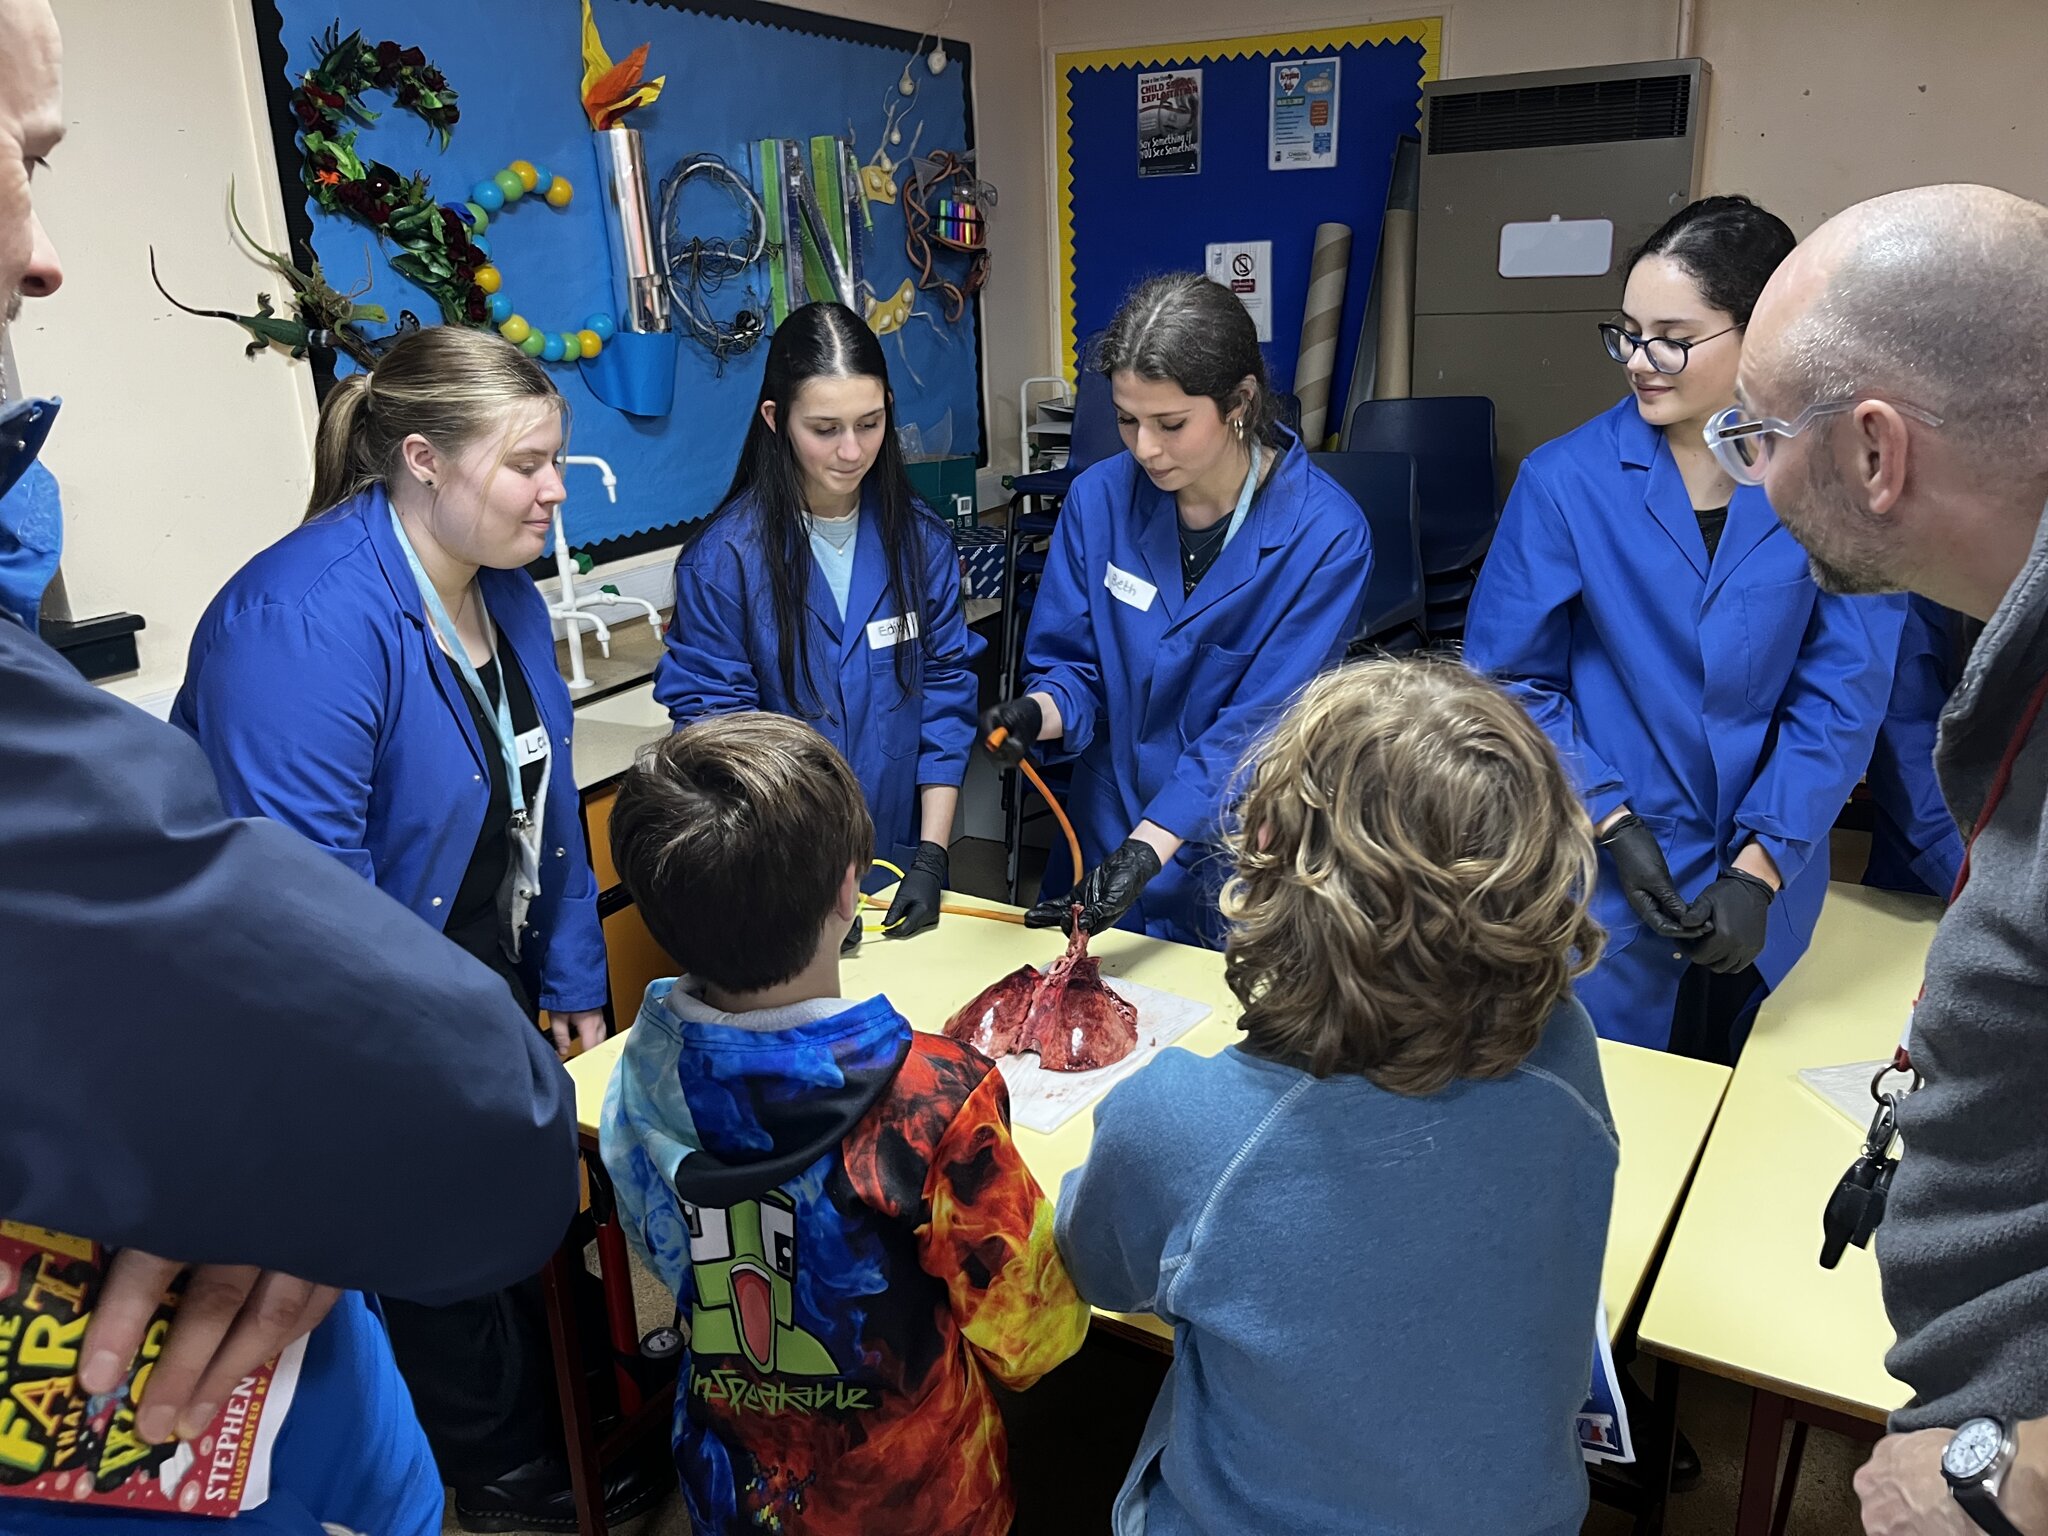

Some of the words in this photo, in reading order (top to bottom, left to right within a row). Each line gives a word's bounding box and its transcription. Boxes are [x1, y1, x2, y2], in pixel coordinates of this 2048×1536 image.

[1141, 83, 1164, 94] CHILD
[0, 1253, 92, 1473] FART
[204, 1376, 257, 1501] STEPHEN
[228, 1401, 261, 1500] ILLUSTRATED
[255, 1375, 268, 1395] BY
